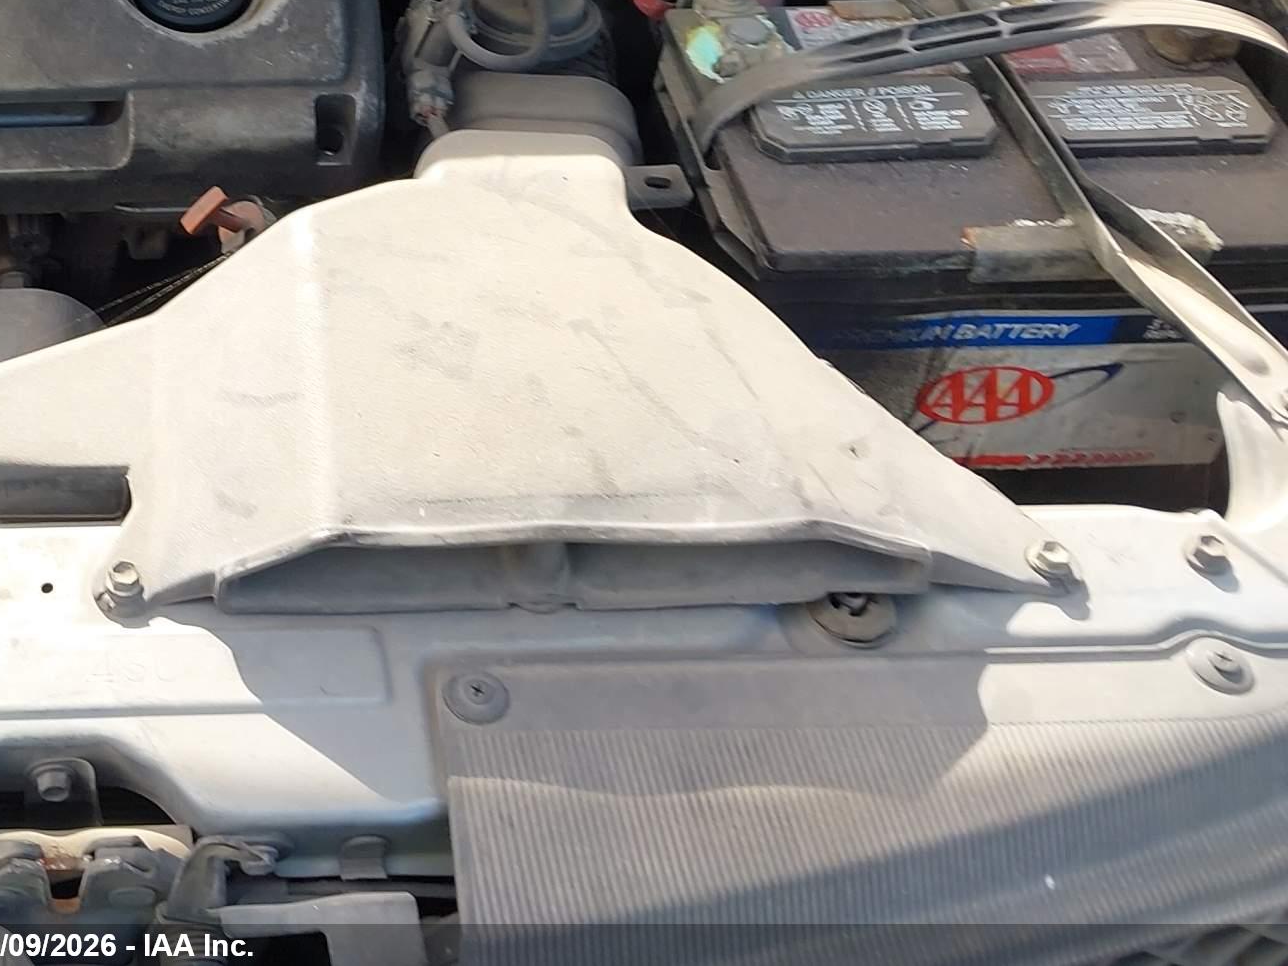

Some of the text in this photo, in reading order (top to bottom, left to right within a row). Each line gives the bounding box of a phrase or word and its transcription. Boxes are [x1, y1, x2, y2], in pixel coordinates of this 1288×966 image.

[806, 87, 866, 99] DANGER
[877, 84, 934, 97] POISON
[955, 322, 1082, 340] BATTERY
[930, 367, 1044, 423] AAA
